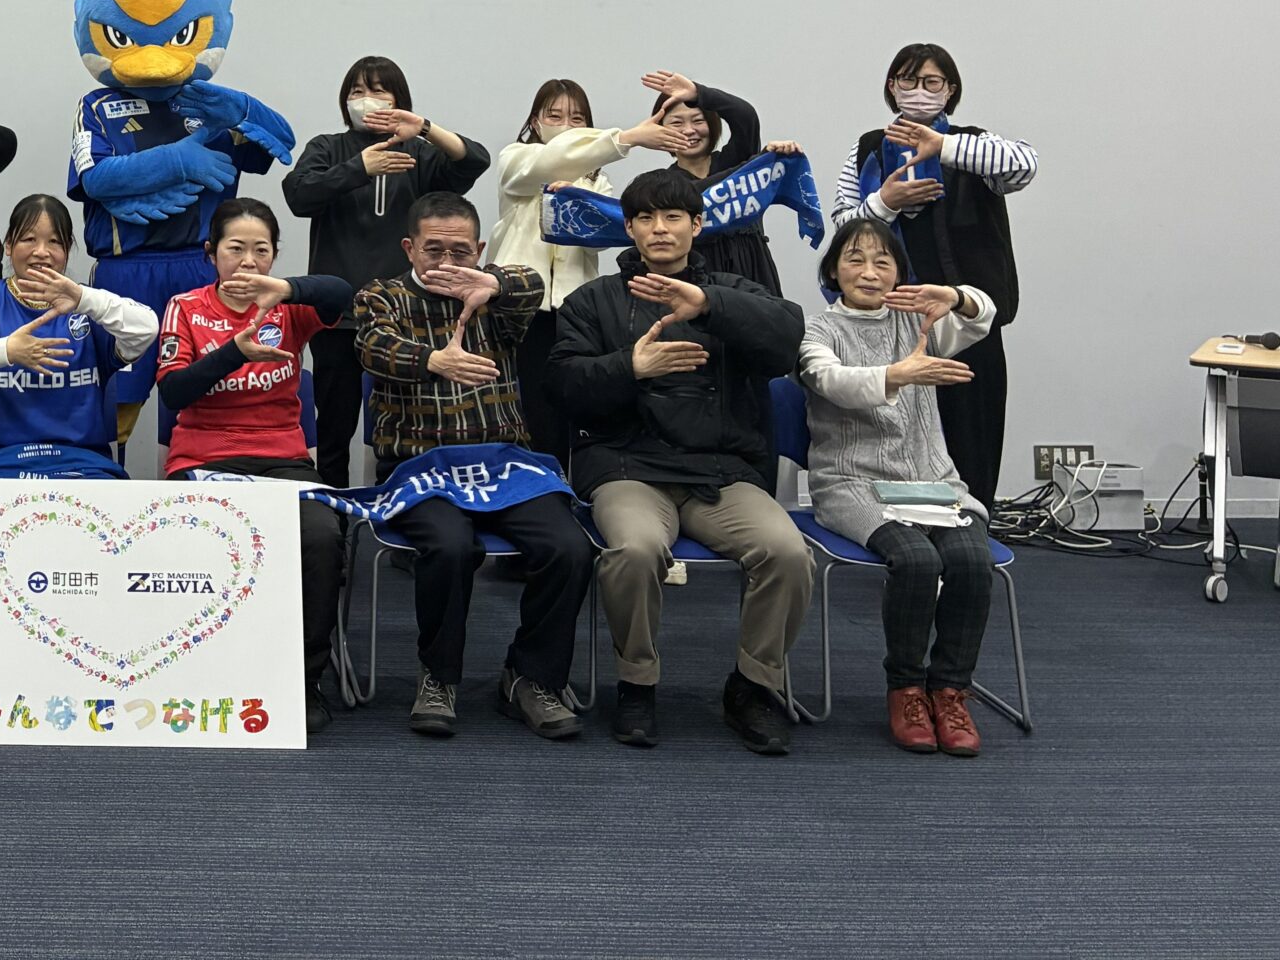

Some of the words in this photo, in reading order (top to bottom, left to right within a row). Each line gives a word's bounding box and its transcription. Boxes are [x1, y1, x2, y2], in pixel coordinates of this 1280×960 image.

[702, 161, 786, 208] CHIDA
[701, 195, 762, 228] LVIA
[52, 571, 99, 587] 町田市
[127, 572, 216, 594] ZELVIA
[167, 572, 213, 580] MACHIDA
[85, 588, 98, 596] City
